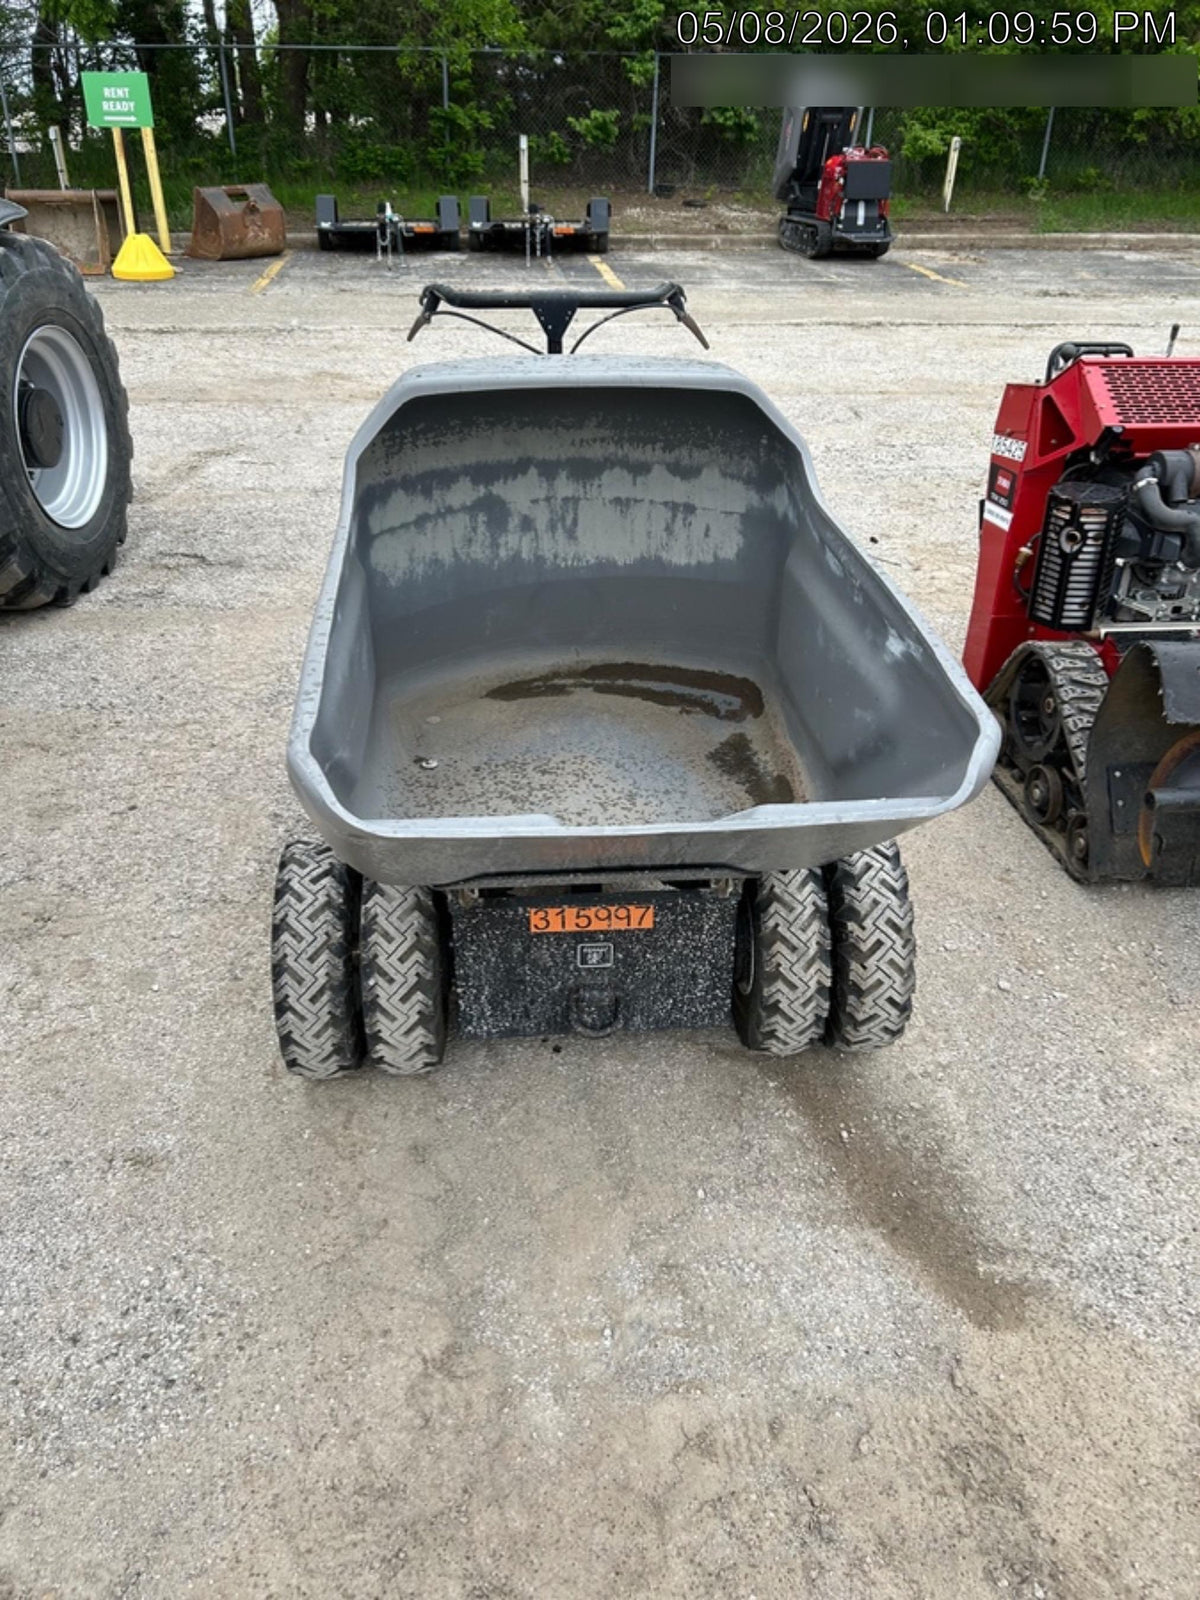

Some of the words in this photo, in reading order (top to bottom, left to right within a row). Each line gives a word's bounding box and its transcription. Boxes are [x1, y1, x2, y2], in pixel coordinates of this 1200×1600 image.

[103, 87, 129, 98] RENT
[102, 101, 135, 112] READY
[533, 905, 651, 931] 315997
